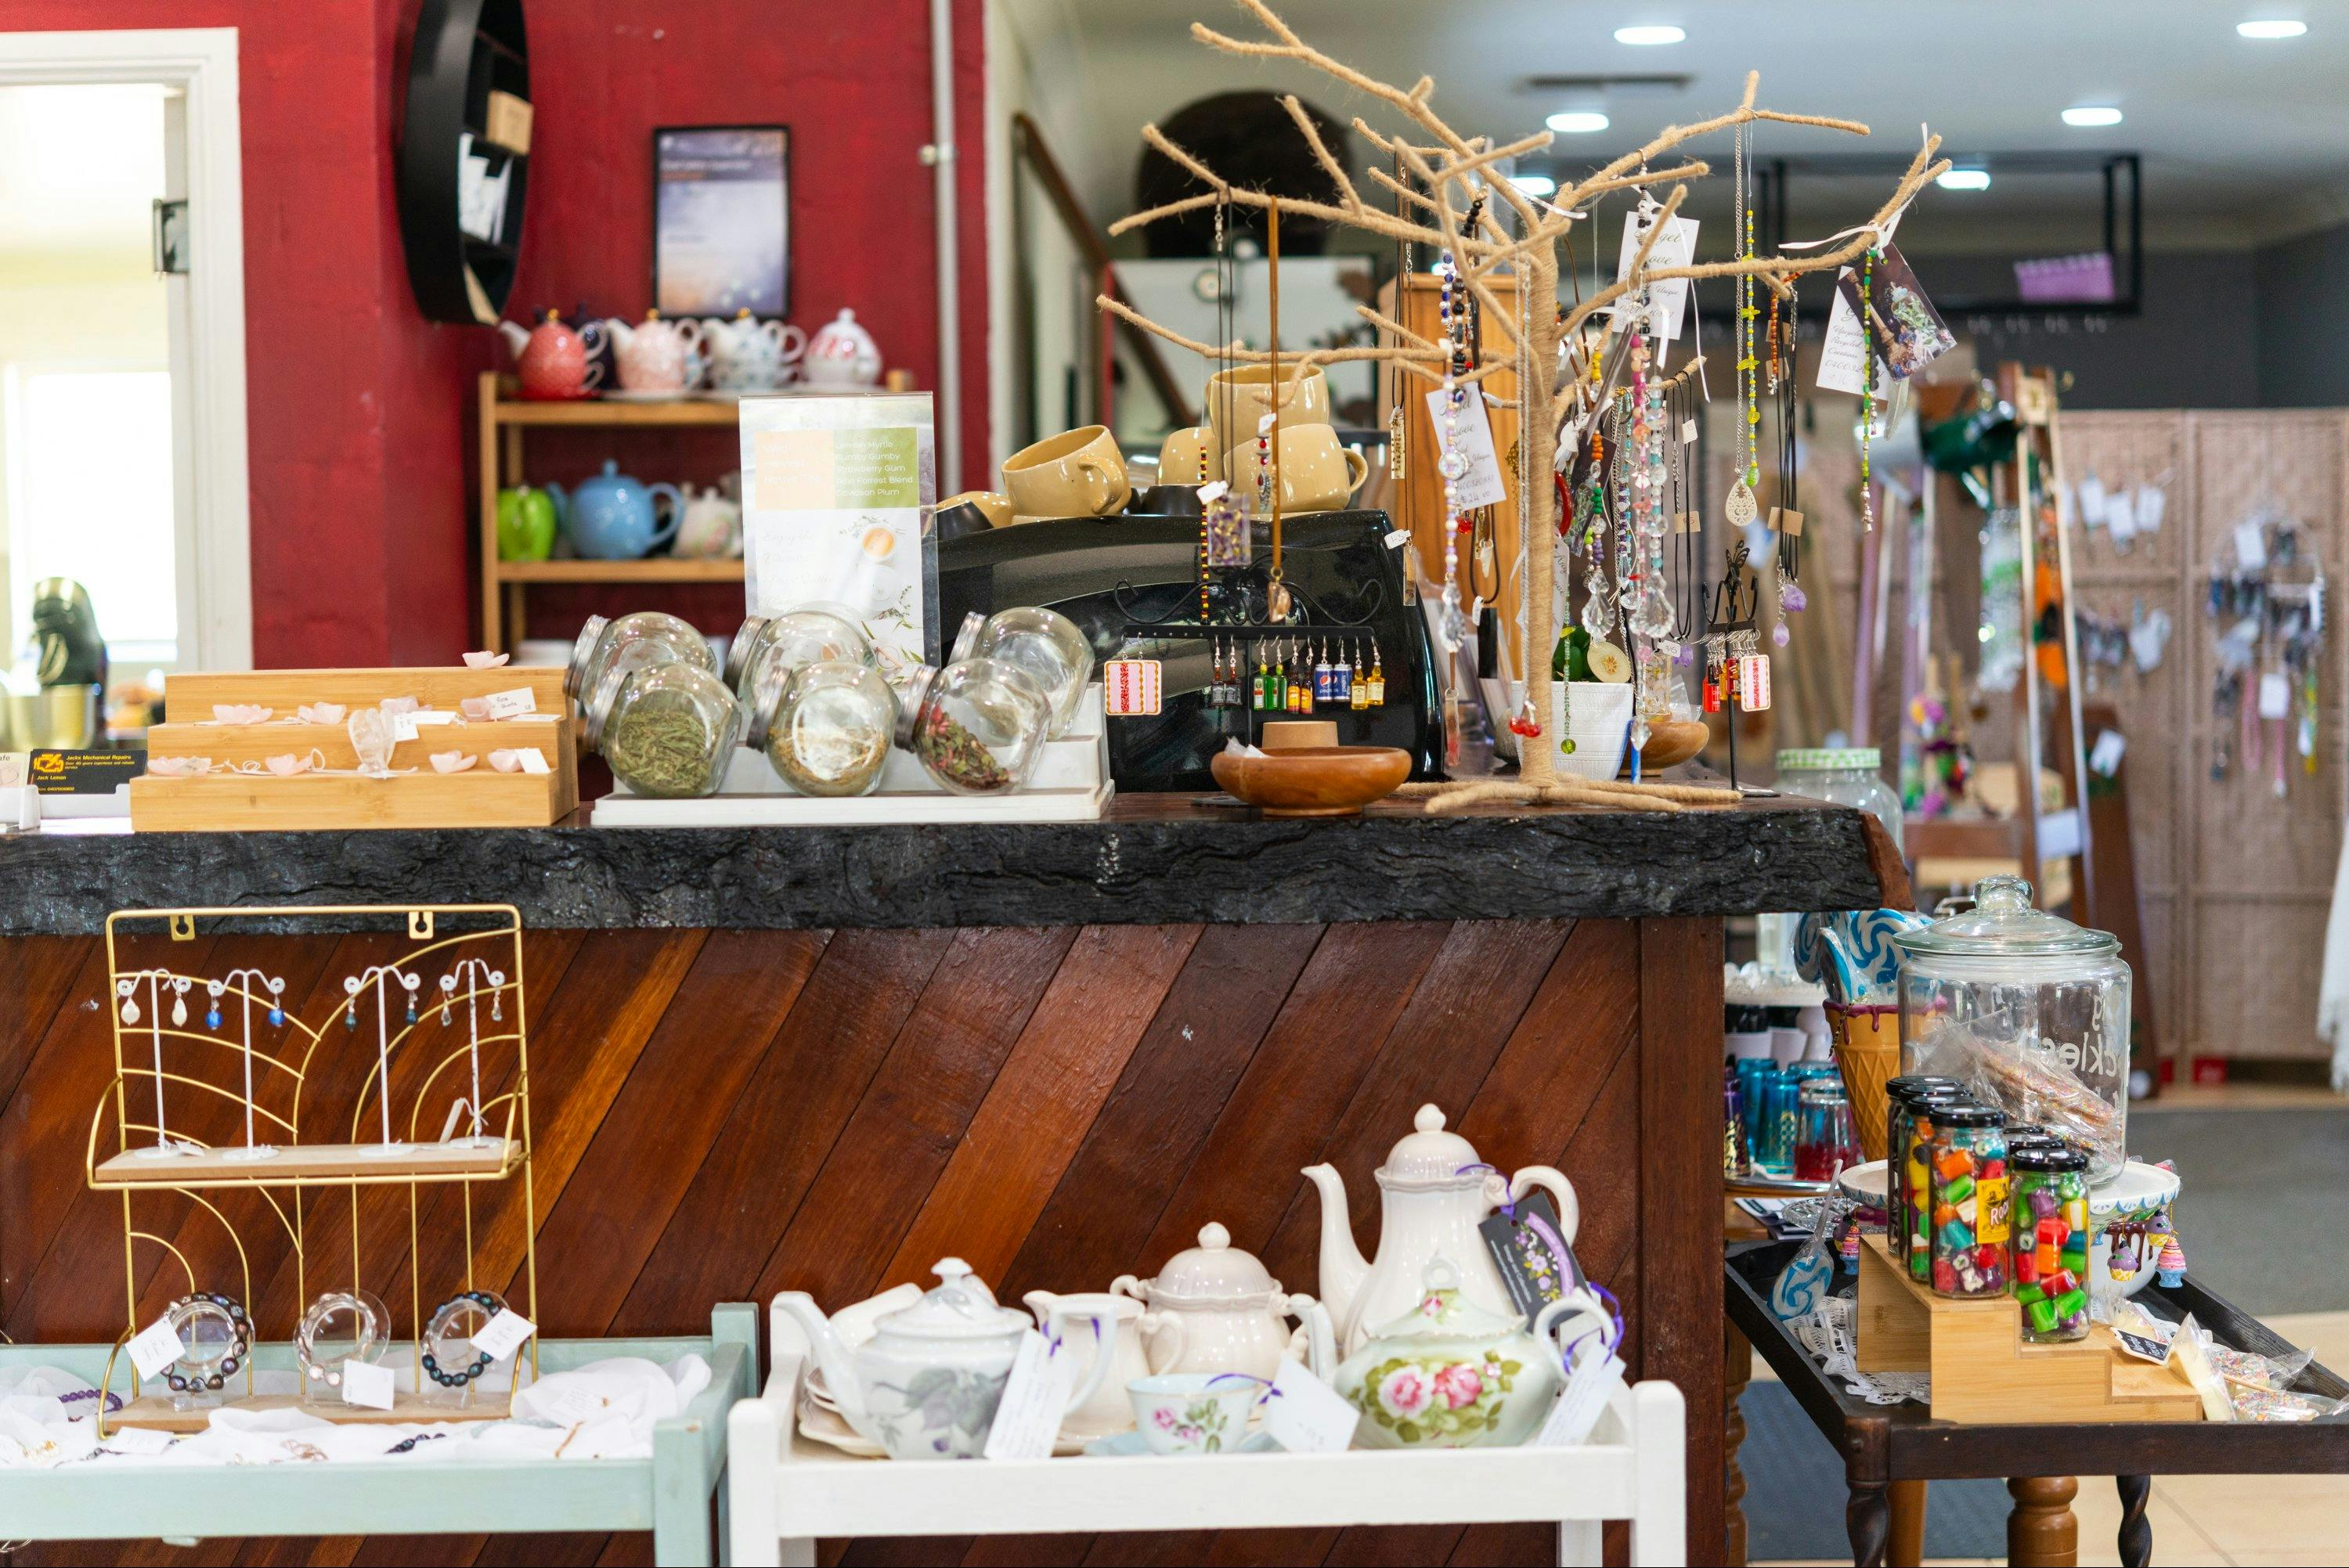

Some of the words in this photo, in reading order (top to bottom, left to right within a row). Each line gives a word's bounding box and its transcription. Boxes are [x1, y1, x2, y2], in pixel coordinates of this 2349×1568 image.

[868, 440, 893, 450] Myrtle
[869, 452, 900, 461] Gumby
[889, 475, 914, 484] Blend
